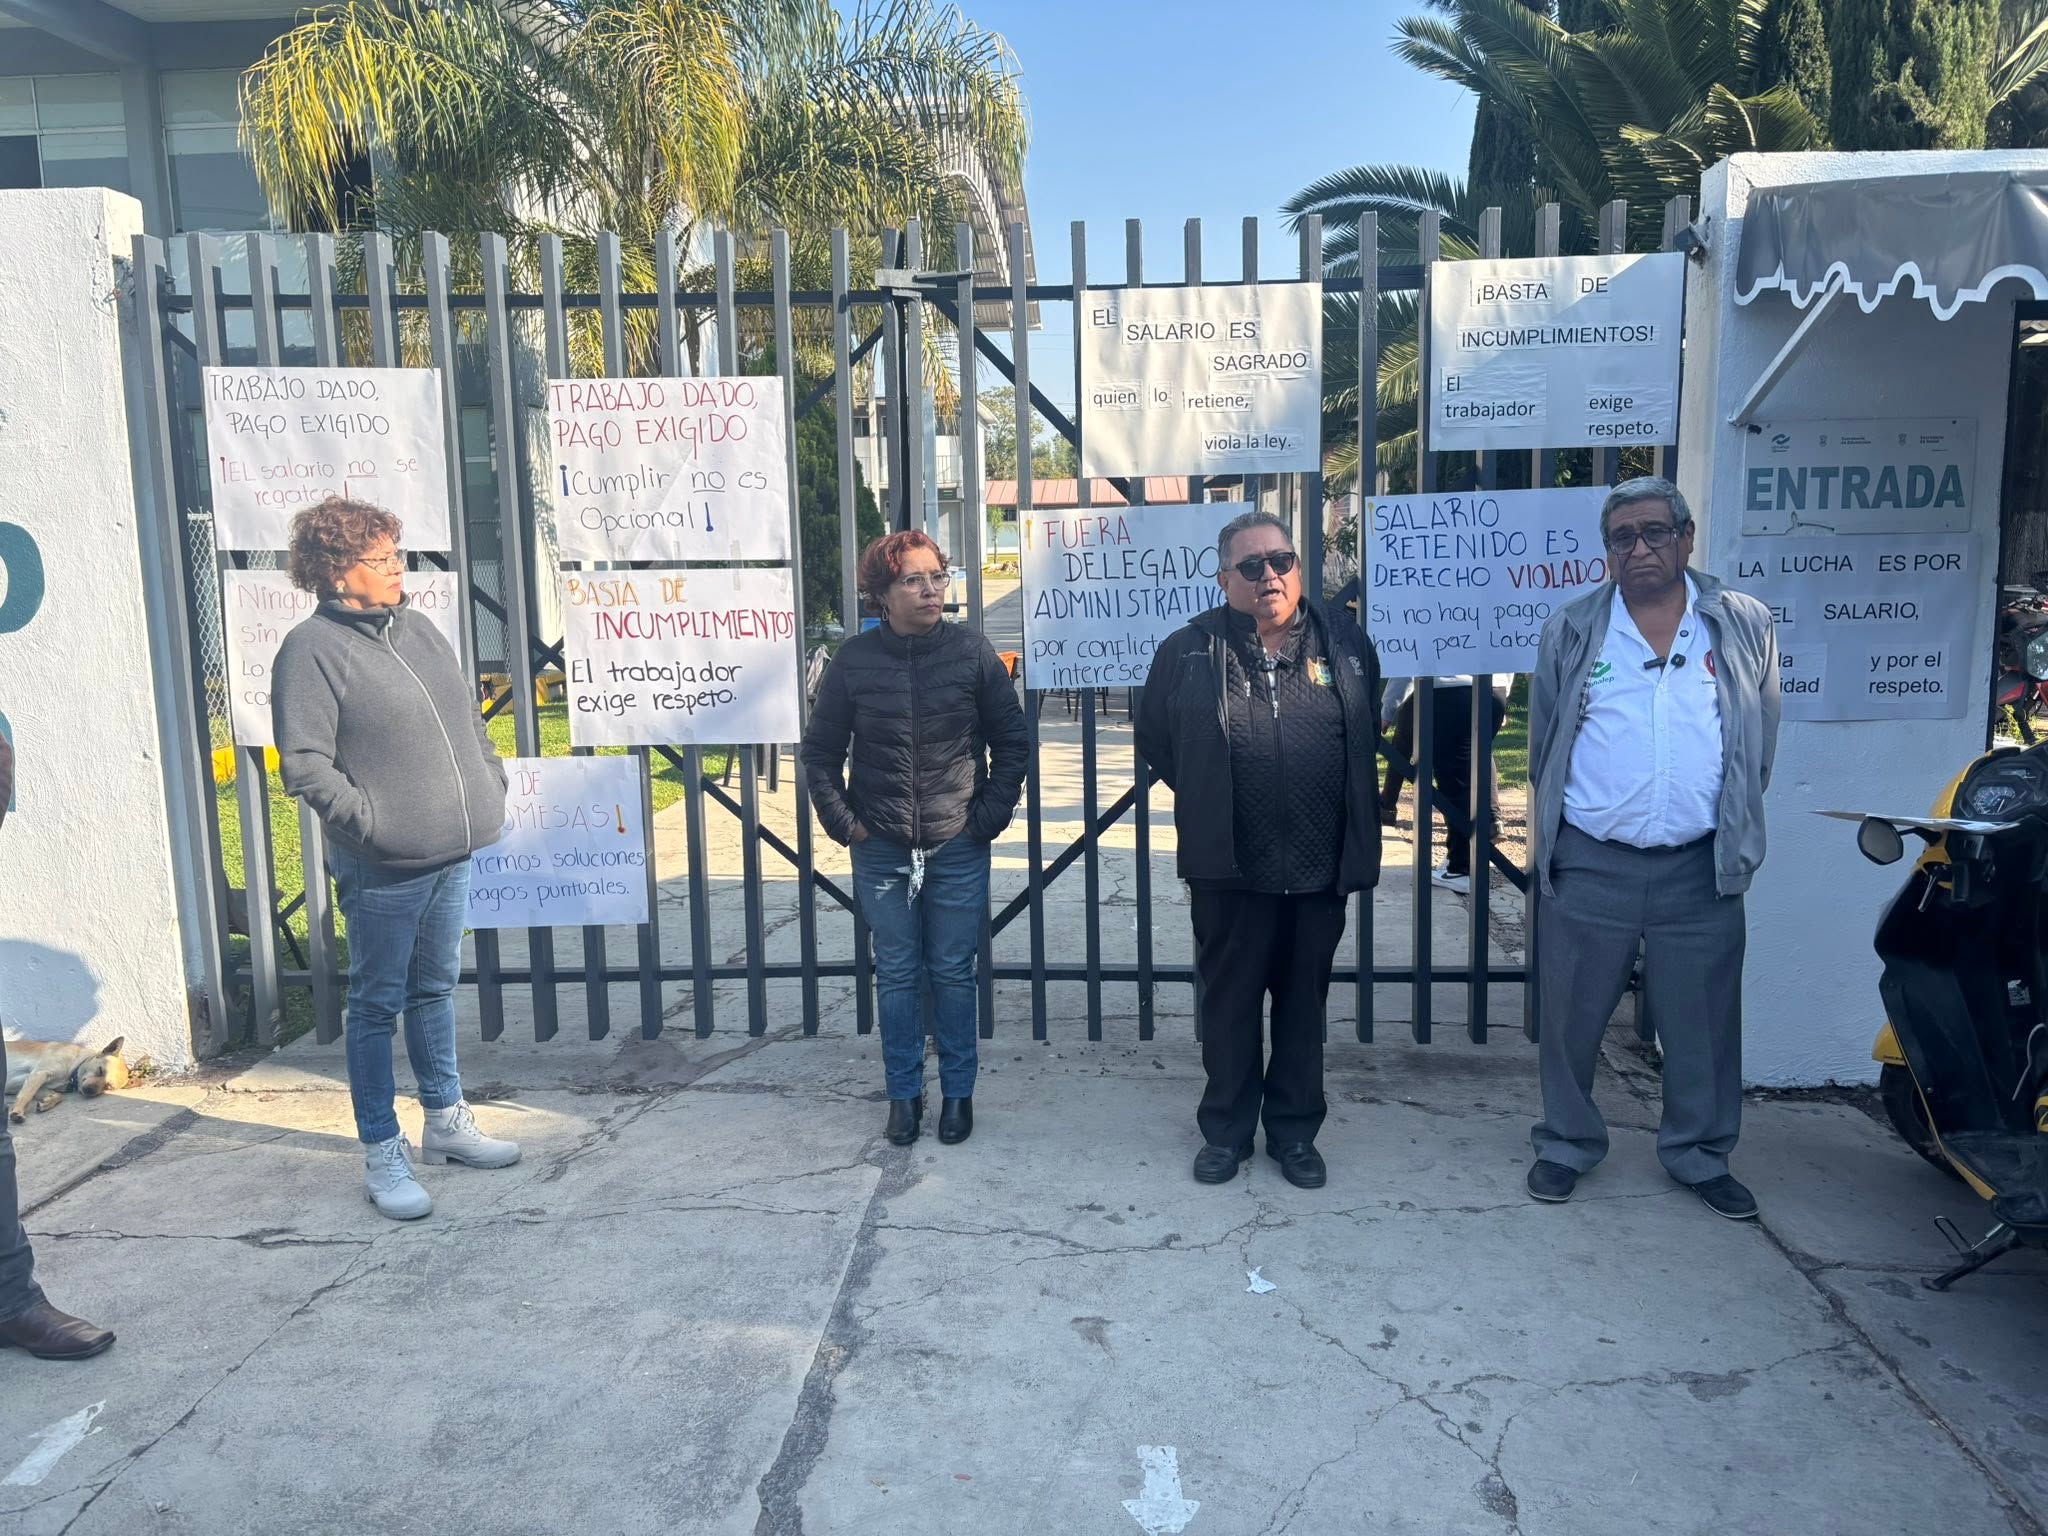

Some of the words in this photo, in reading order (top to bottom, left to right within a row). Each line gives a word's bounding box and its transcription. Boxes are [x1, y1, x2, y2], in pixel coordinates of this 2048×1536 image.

[1477, 283, 1548, 305] ¡BASTA
[1581, 277, 1608, 294] DE
[1093, 309, 1117, 326] EL
[1127, 322, 1215, 341] SALARIO
[1230, 322, 1256, 339] ES
[1462, 325, 1654, 348] INCUMPLIMIENTOS!
[1213, 353, 1307, 371] SAGRADO
[210, 374, 305, 401] TRABAJO
[317, 380, 379, 401] DADO,
[551, 382, 665, 413] TRABAJO
[683, 381, 758, 409] DADO,
[1446, 376, 1460, 392] El
[1093, 391, 1137, 408] quien
[1154, 388, 1168, 402] lo
[1188, 394, 1249, 410] retiene,
[1445, 401, 1536, 420] trabajador
[1589, 394, 1634, 413] exige
[226, 412, 287, 439] PAGO
[300, 414, 390, 438] EXIGIDO
[554, 419, 622, 453] PAGO
[636, 413, 747, 460] EXIGIDO
[1588, 422, 1659, 438] respeto.
[1205, 435, 1241, 450] viola
[1246, 434, 1259, 449] la
[1264, 434, 1291, 450] ley.
[261, 457, 335, 479] salario
[348, 459, 377, 475] no
[397, 457, 418, 472] se
[692, 471, 726, 490] no
[738, 471, 767, 489] es
[1746, 464, 1966, 512] ENTRADA
[1380, 531, 1527, 561] RETENIDO
[1546, 529, 1579, 556] ES
[1063, 546, 1220, 587] DELEGADO
[1374, 564, 1490, 588] DERECHO
[1738, 561, 1765, 578] LA
[1781, 555, 1853, 573] LUCHA
[1879, 555, 1906, 572] ES
[1914, 553, 1961, 571] POR
[567, 577, 640, 606] BASTA
[659, 576, 688, 603] DE
[1403, 608, 1431, 625] no
[1438, 601, 1480, 630] hay
[1495, 602, 1551, 630] pago
[1824, 602, 1919, 621] SALARIO,
[592, 609, 795, 642] INCUMPLIMIENTOS
[1032, 639, 1066, 663] por
[1077, 632, 1163, 663] conflict
[1372, 634, 1419, 660] hay
[1433, 634, 1477, 660] paz
[572, 658, 593, 683] El
[607, 660, 742, 689] trabajador
[1870, 655, 1880, 672] y
[1887, 655, 1918, 673] por
[1924, 652, 1941, 667] el
[1780, 677, 1820, 693] idad
[1869, 678, 1944, 696] respeto.
[577, 691, 637, 716] exige
[652, 689, 737, 715] respeto.
[515, 770, 543, 796] DE
[471, 853, 541, 875] remos
[552, 848, 645, 868] soluciones
[469, 885, 528, 912] pagos
[537, 878, 629, 907] puntuales.
